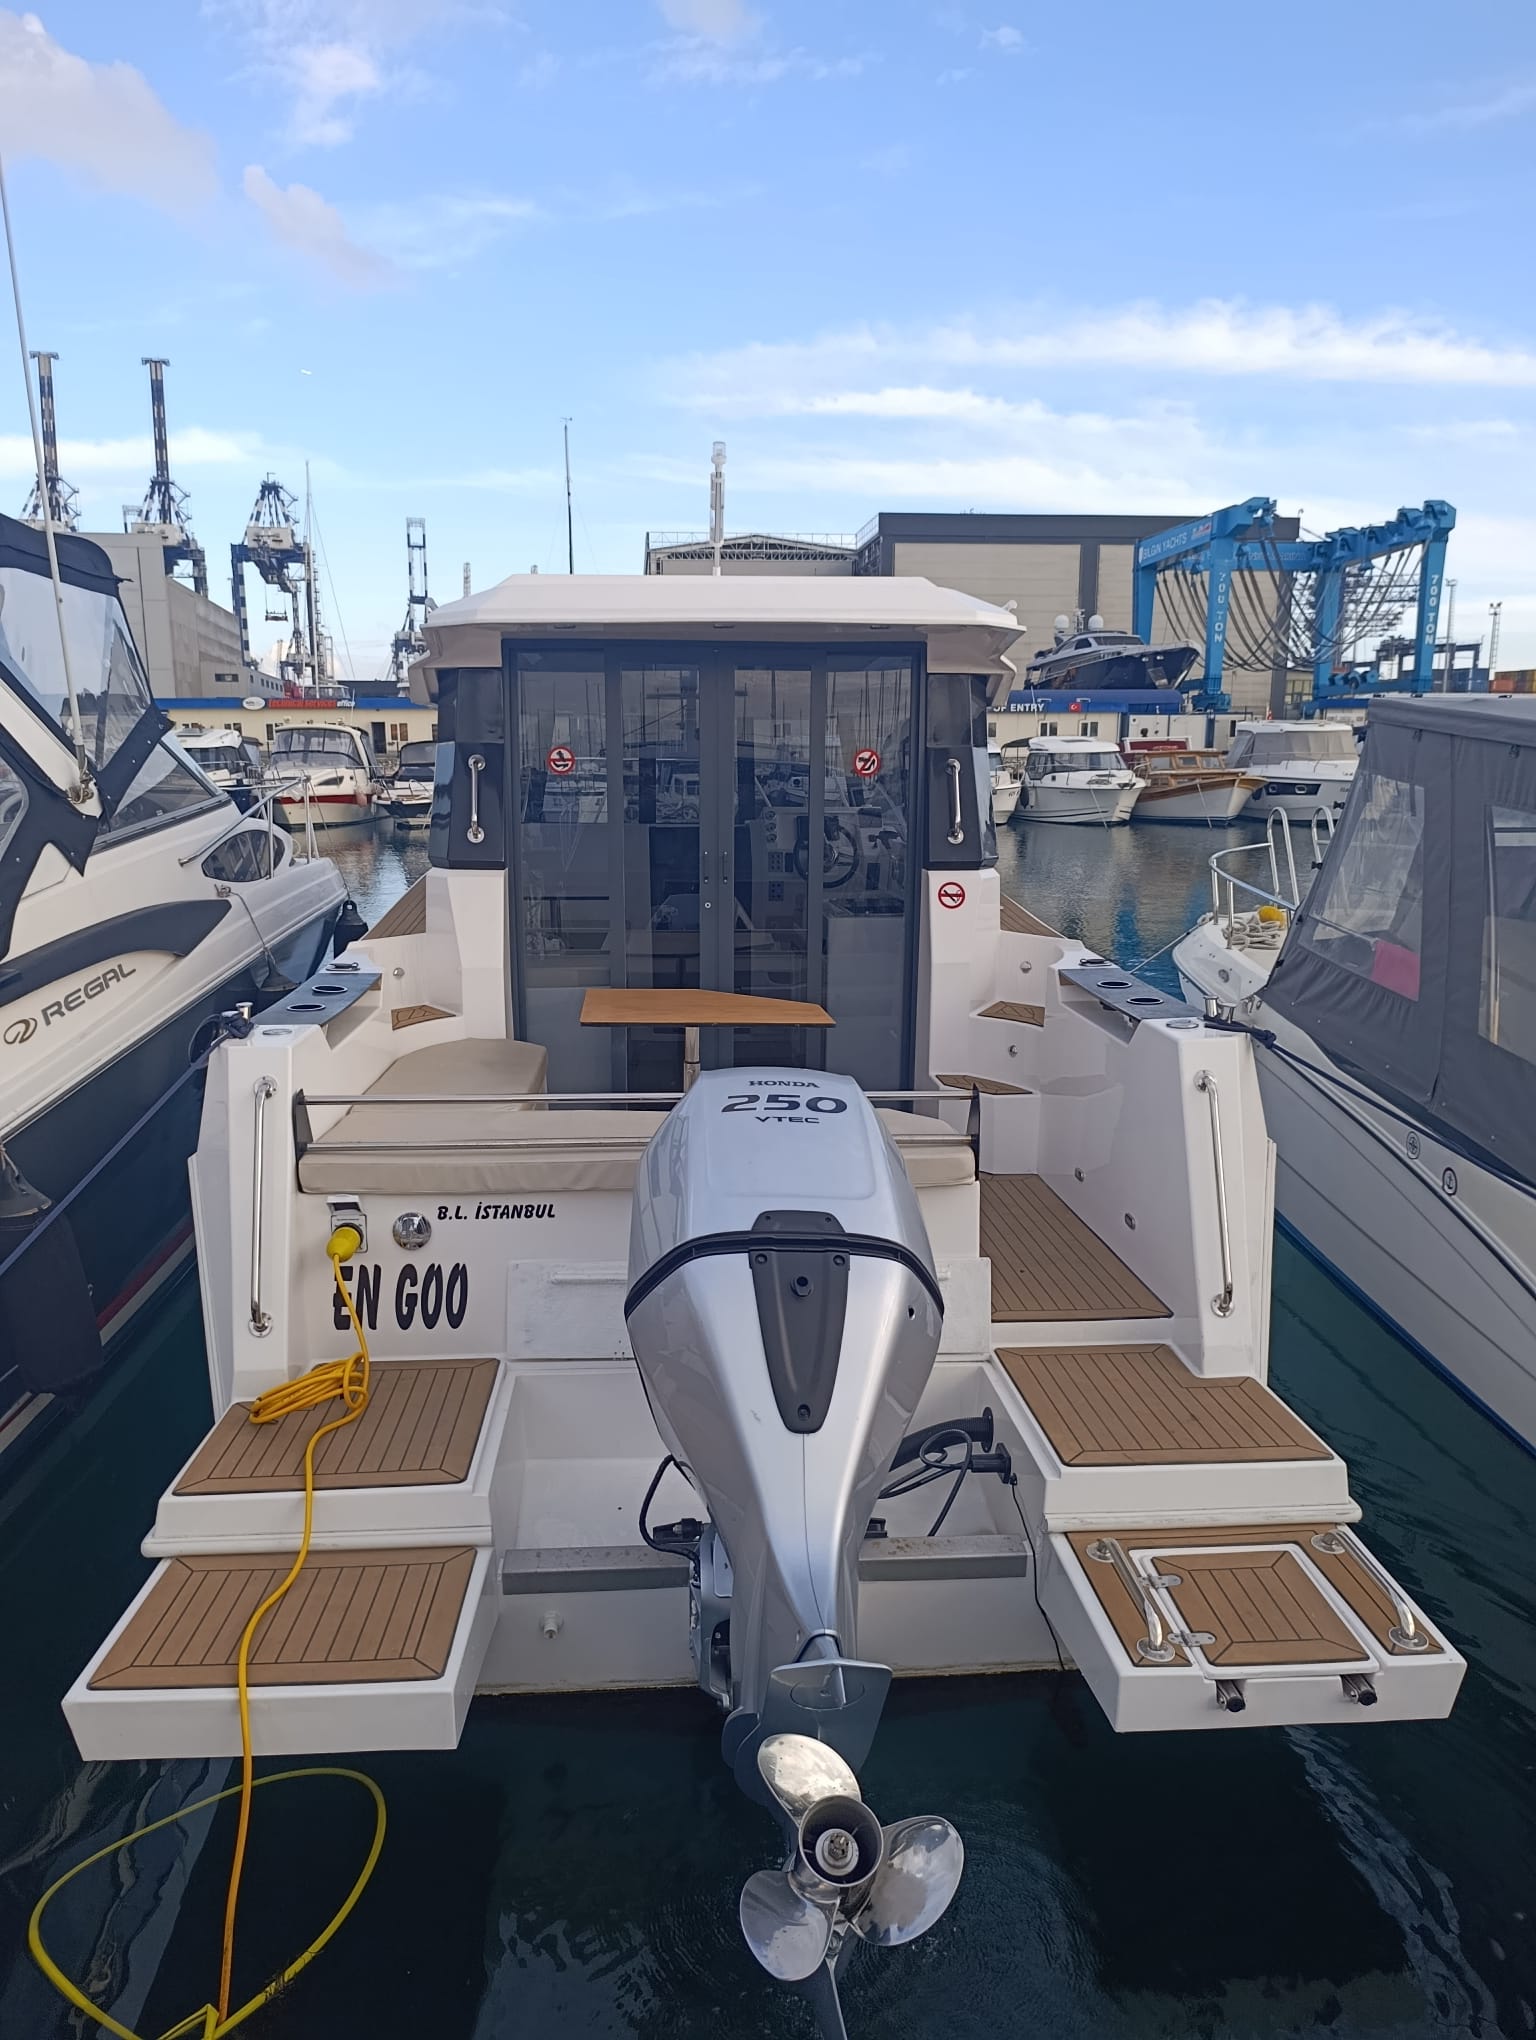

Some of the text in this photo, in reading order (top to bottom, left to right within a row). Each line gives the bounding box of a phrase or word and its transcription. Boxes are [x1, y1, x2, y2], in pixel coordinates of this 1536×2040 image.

[1424, 574, 1440, 645] 700 TON
[1214, 611, 1224, 643] TON
[1010, 703, 1045, 712] ENTRY
[41, 963, 137, 1027] REGAL
[748, 1080, 821, 1089] HONDA
[720, 1094, 848, 1114] 250
[754, 1116, 821, 1124] VTEC
[437, 1201, 556, 1221] B.L. İSTANBUL
[333, 1262, 469, 1331] EN GOO
